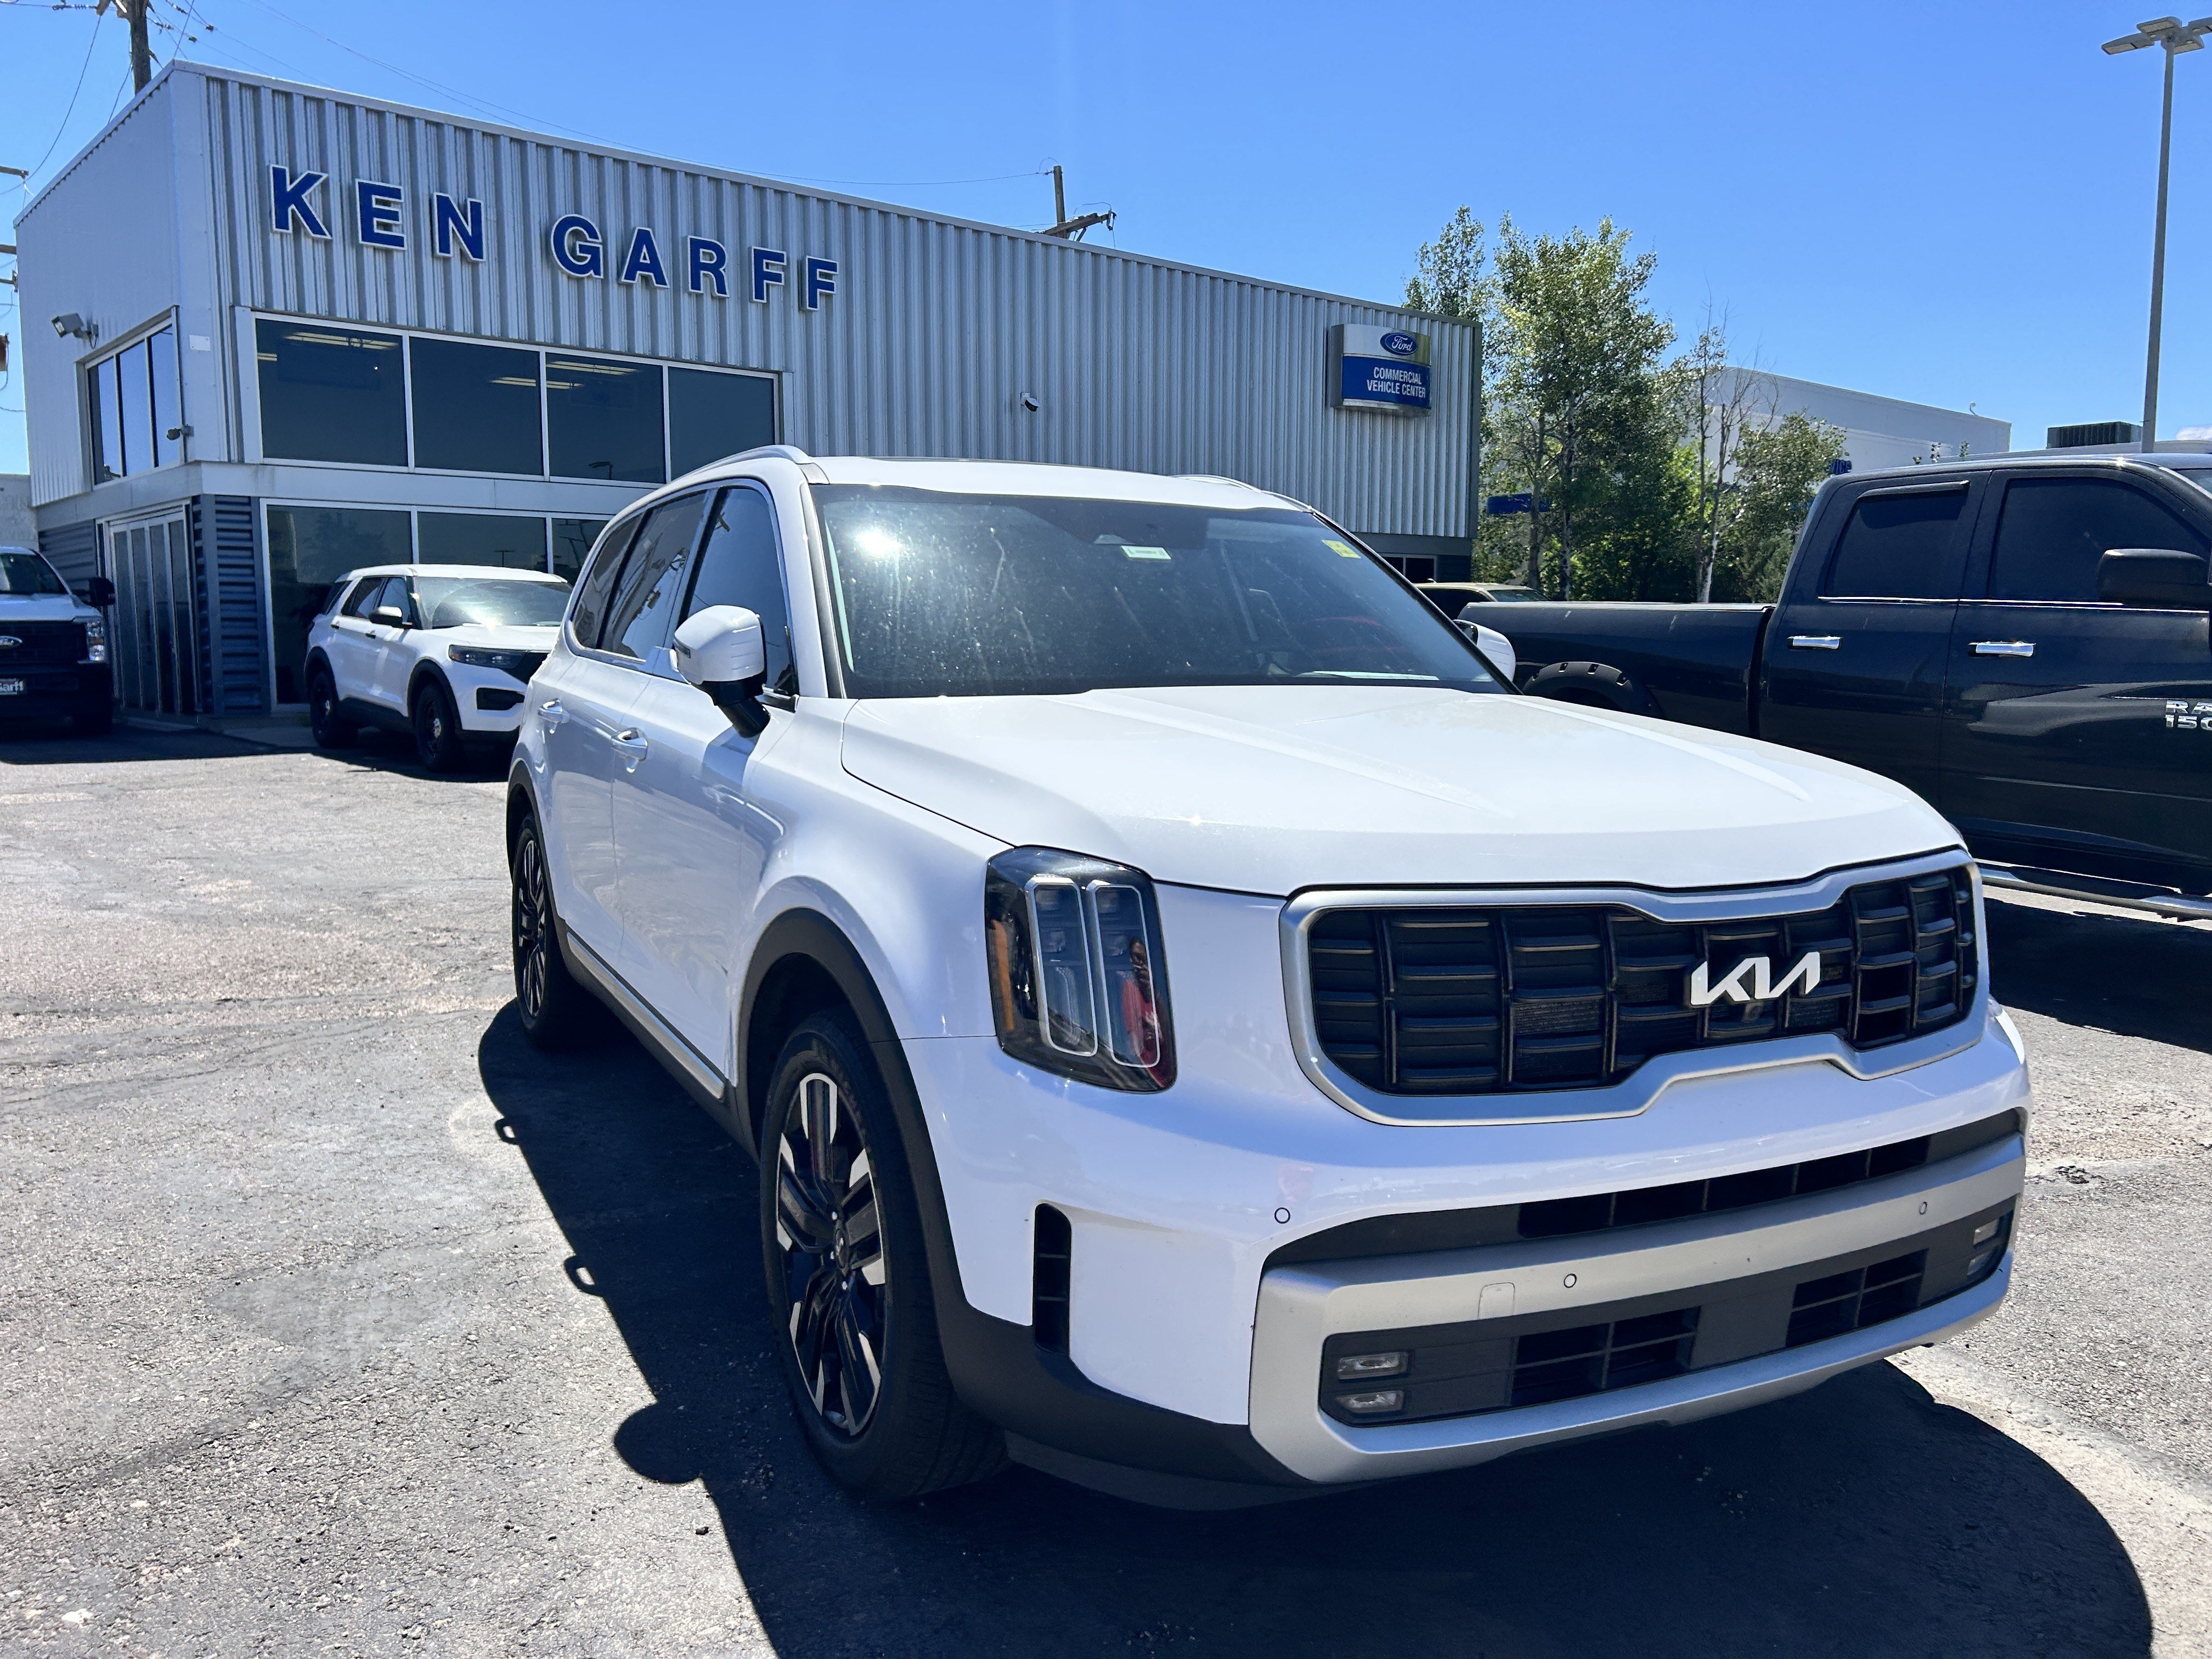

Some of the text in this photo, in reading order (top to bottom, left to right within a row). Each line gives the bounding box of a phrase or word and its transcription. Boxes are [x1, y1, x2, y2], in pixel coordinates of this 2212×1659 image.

[270, 164, 839, 311] KEN GARFF
[1391, 335, 1413, 351] Ford
[1373, 366, 1422, 385] COMMERCIAL
[1366, 379, 1426, 398] VEHICLE CENTER
[1691, 951, 1820, 1005] KIA
